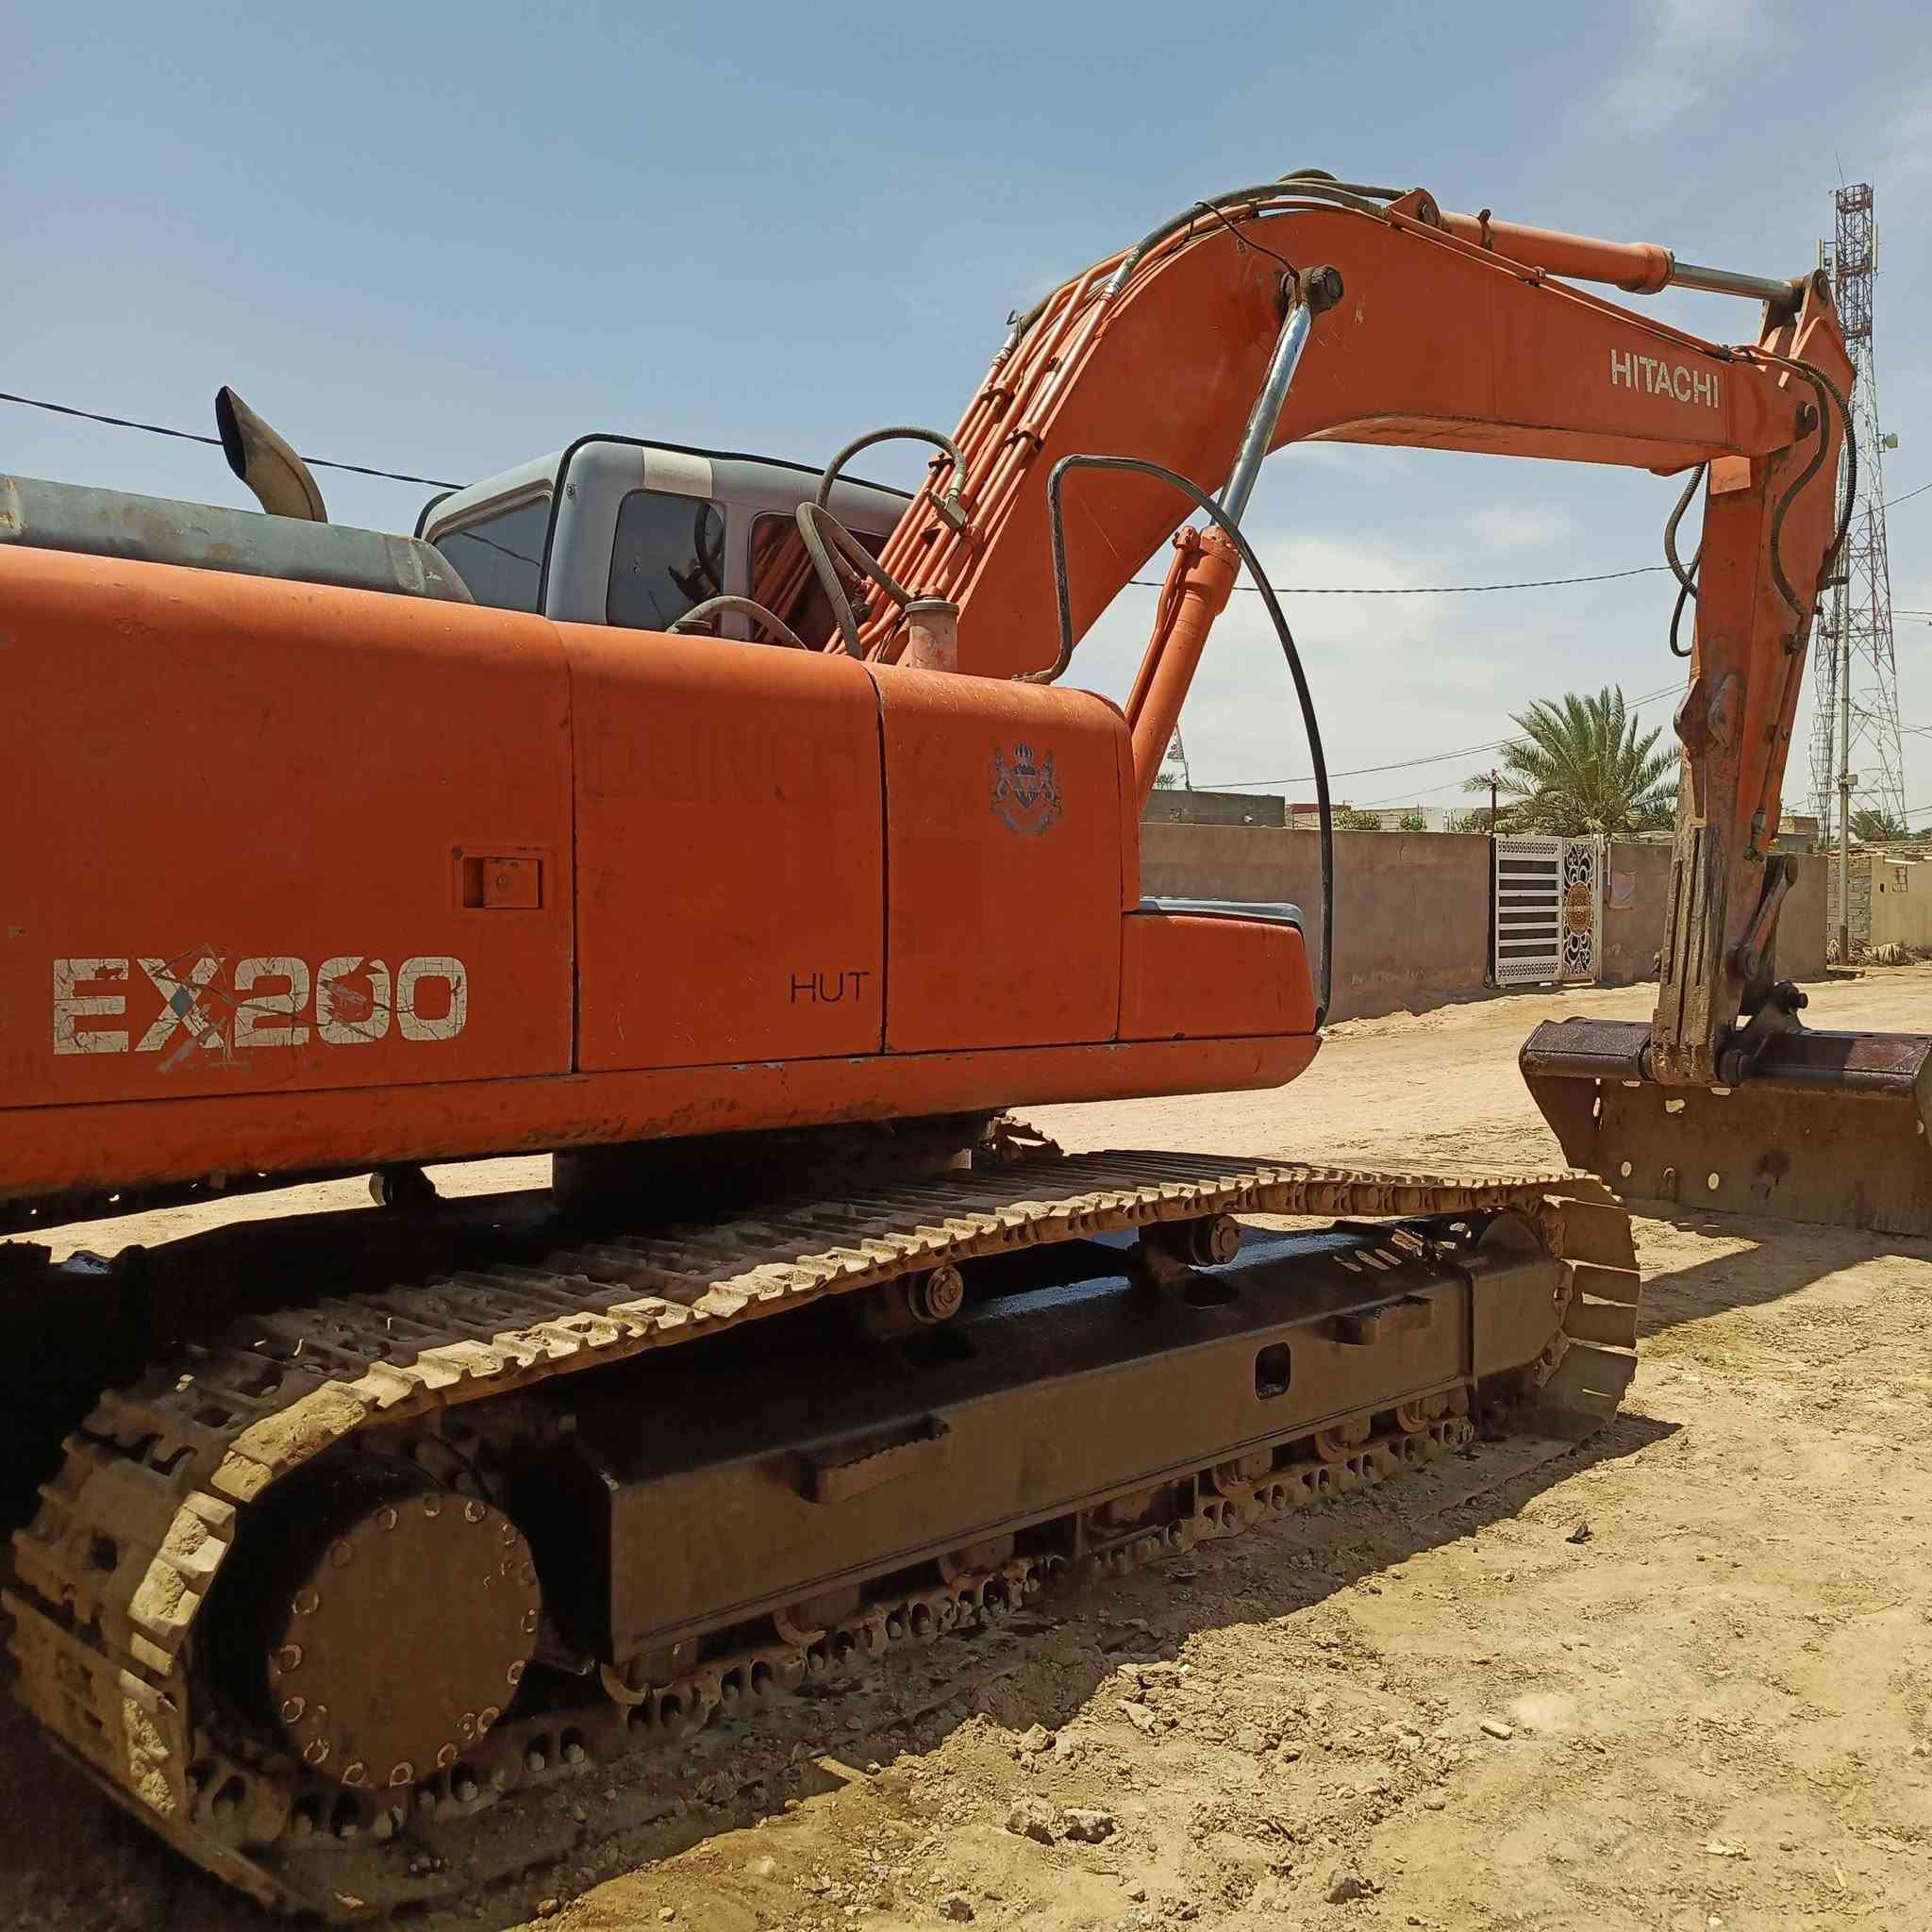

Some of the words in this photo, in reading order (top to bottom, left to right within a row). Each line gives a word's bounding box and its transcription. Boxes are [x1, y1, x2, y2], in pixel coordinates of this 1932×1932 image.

[1610, 348, 1719, 408] HITACHI
[53, 957, 468, 1055] EX200
[791, 971, 870, 1004] HUT
